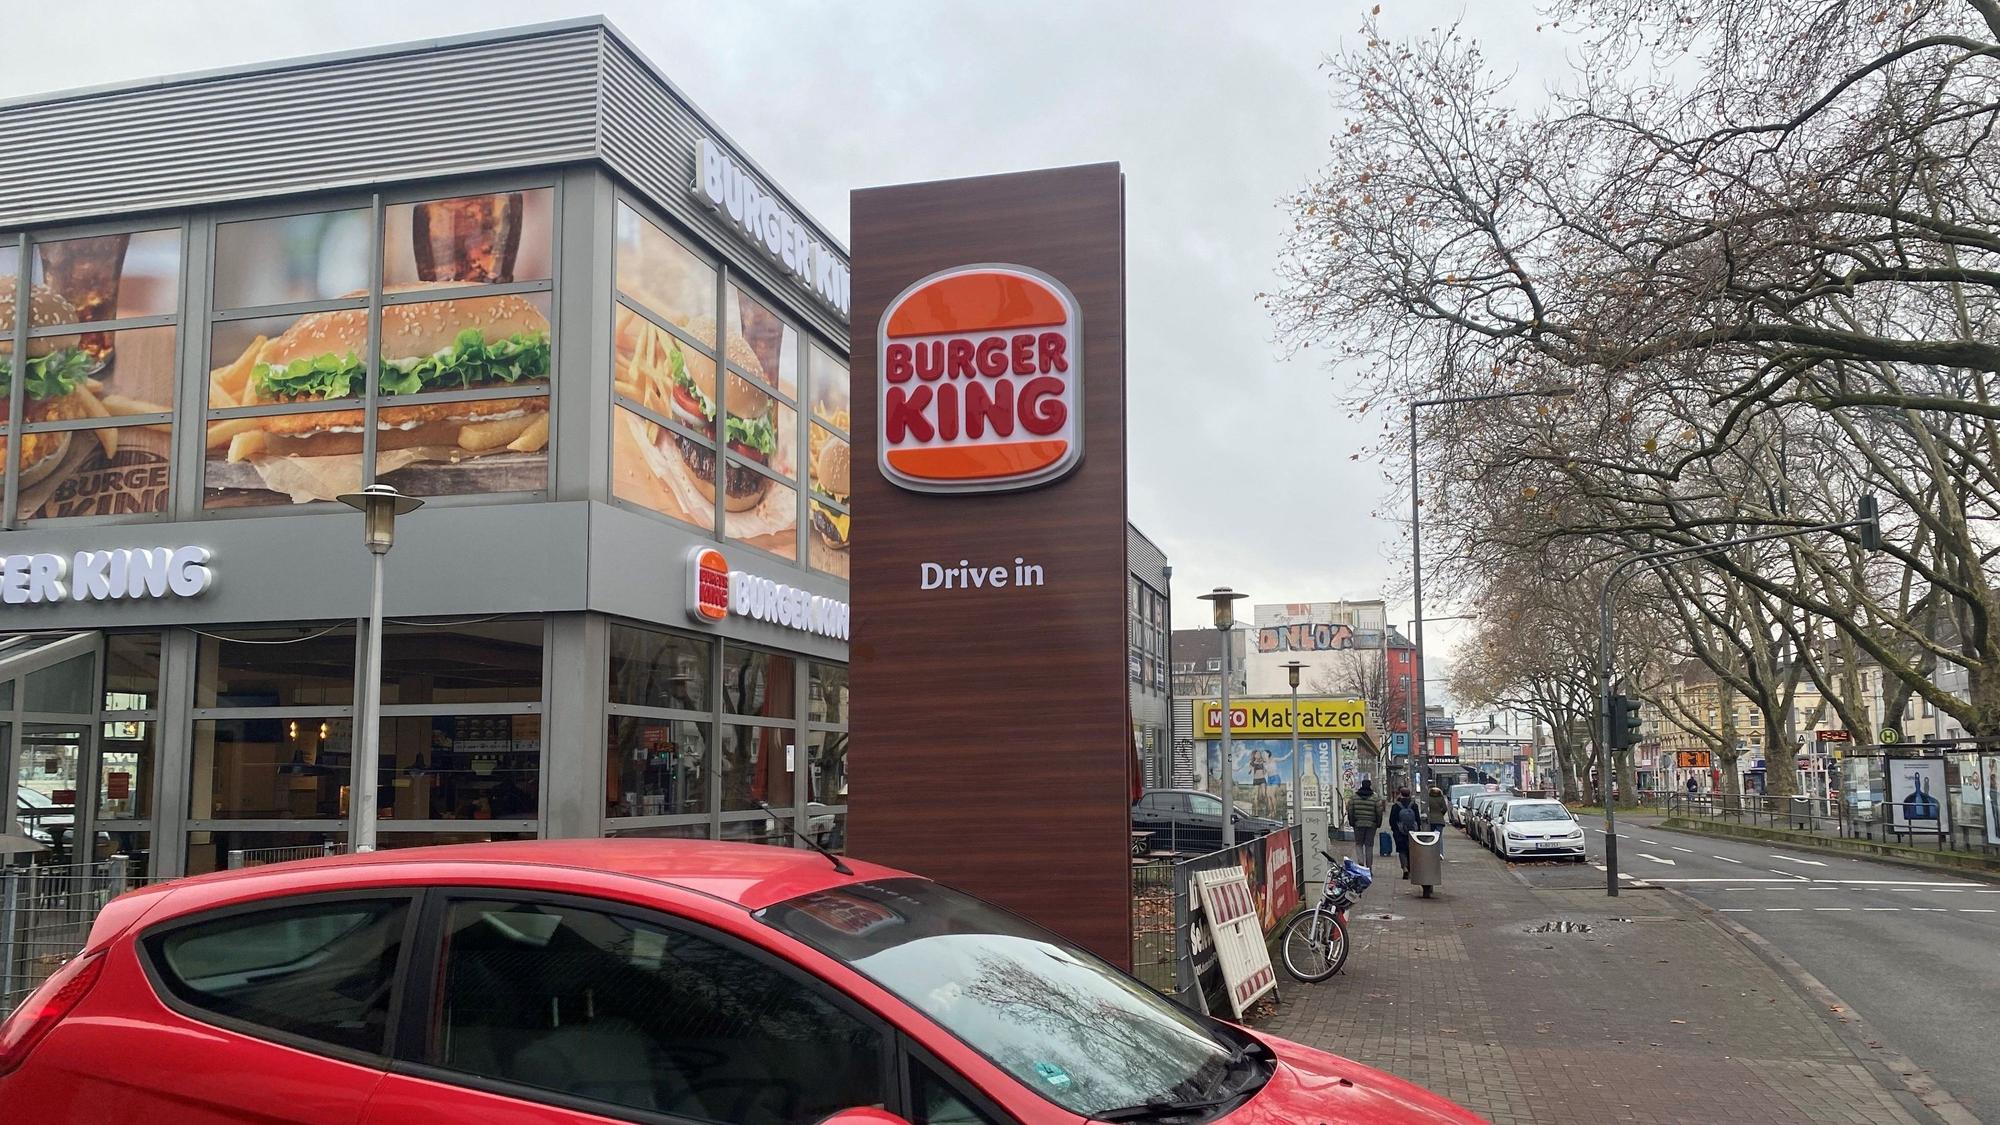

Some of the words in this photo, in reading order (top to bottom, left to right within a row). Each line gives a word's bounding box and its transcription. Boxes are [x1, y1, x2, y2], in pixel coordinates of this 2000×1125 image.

[697, 138, 812, 284] BURGER
[809, 243, 850, 314] KIN
[886, 332, 1068, 384] BURGER
[886, 376, 1068, 444] KING
[55, 466, 169, 503] BURGE
[0, 553, 67, 604] ER
[72, 545, 211, 601] KING
[920, 559, 1009, 590] Drive
[1015, 557, 1044, 587] in
[733, 571, 814, 632] BURGER
[812, 596, 850, 640] KIN
[1319, 742, 1332, 824] FRISCHUNG
